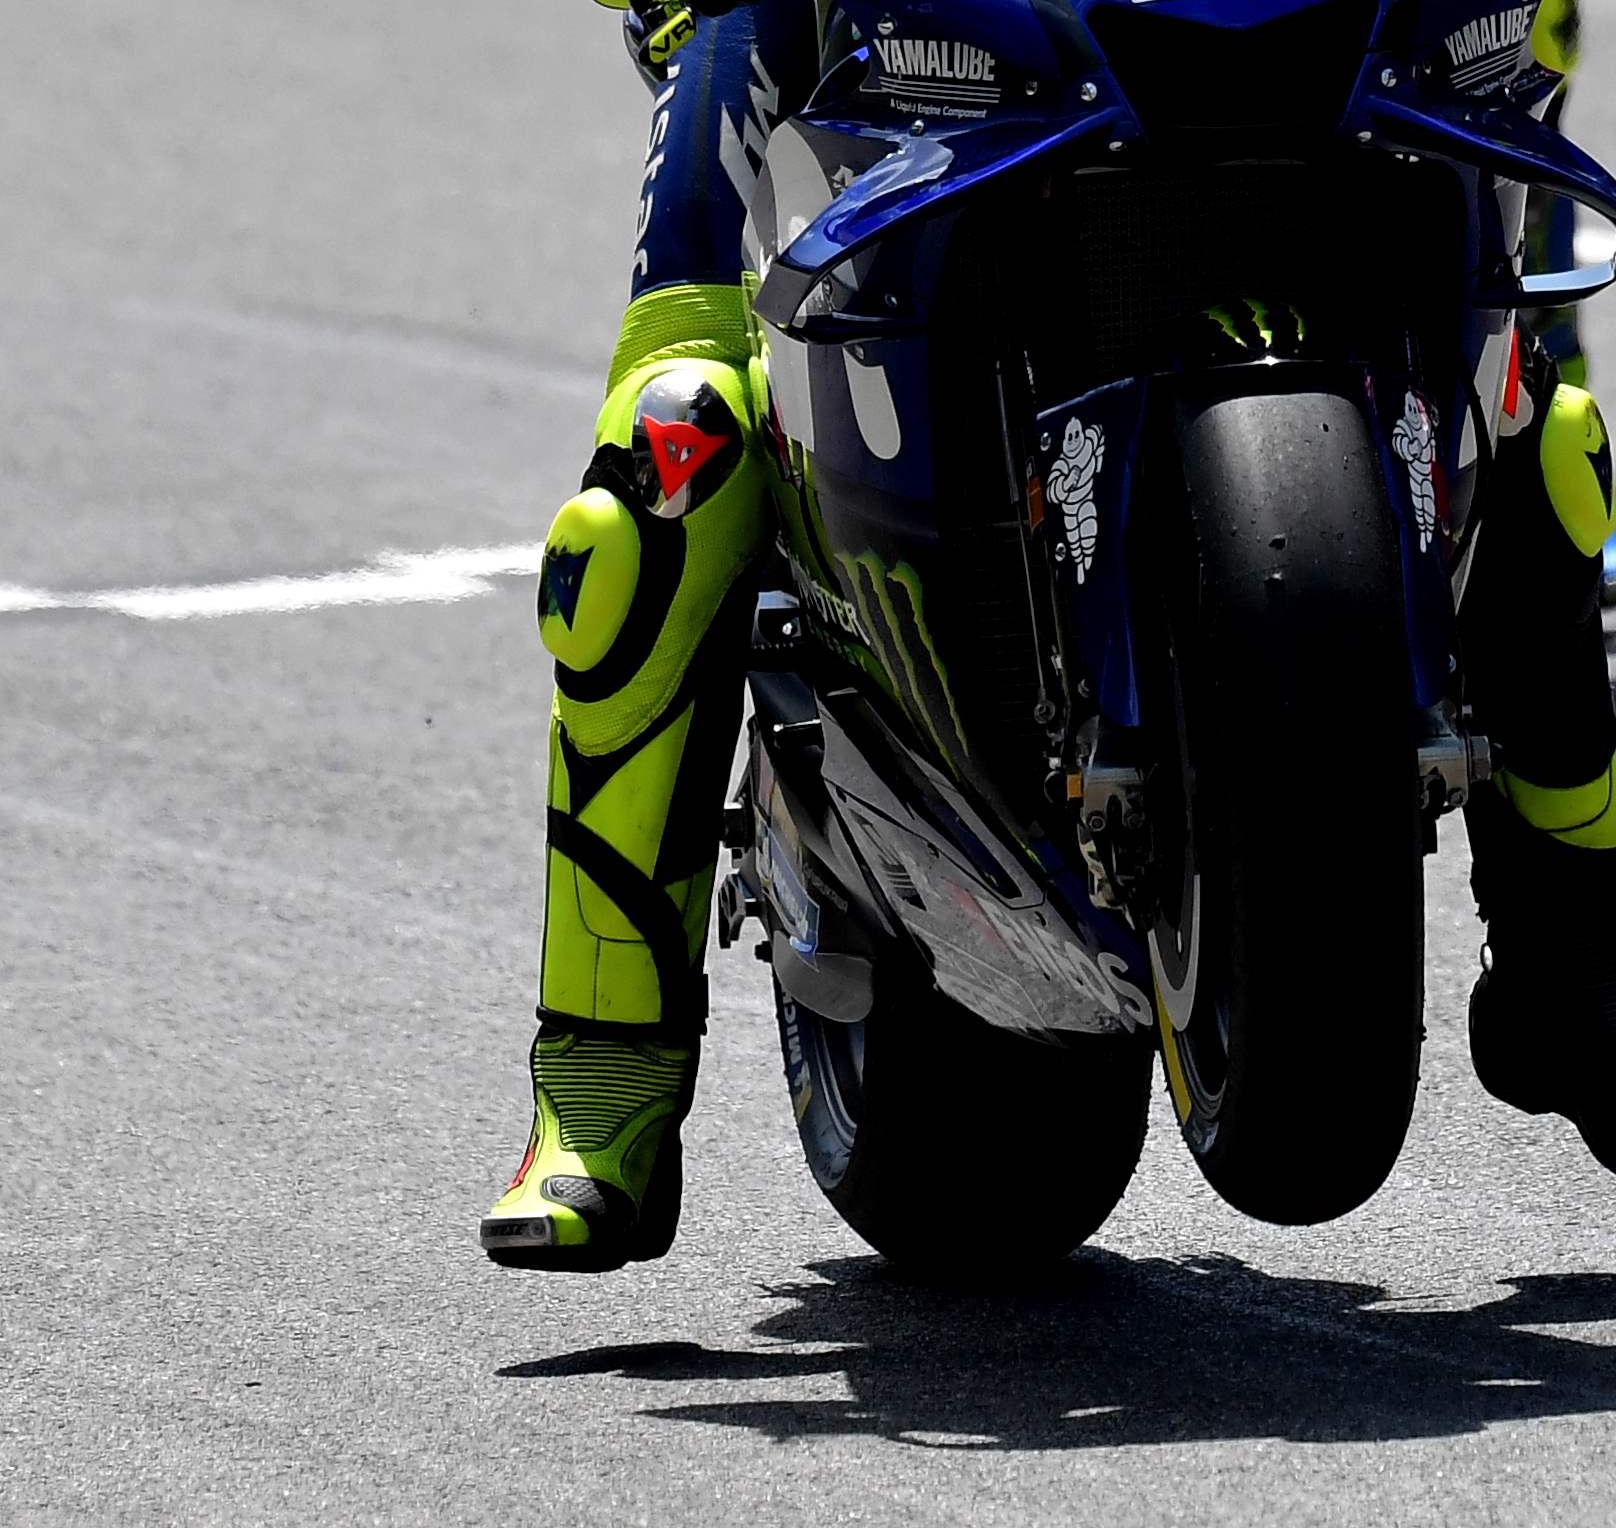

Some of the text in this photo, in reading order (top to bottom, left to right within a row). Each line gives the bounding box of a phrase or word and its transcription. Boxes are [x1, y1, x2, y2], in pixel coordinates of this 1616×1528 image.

[1444, 4, 1534, 66] YAMALUBE
[873, 37, 996, 82] YAMALUBE
[918, 103, 941, 117] Engine
[942, 106, 988, 119] Component
